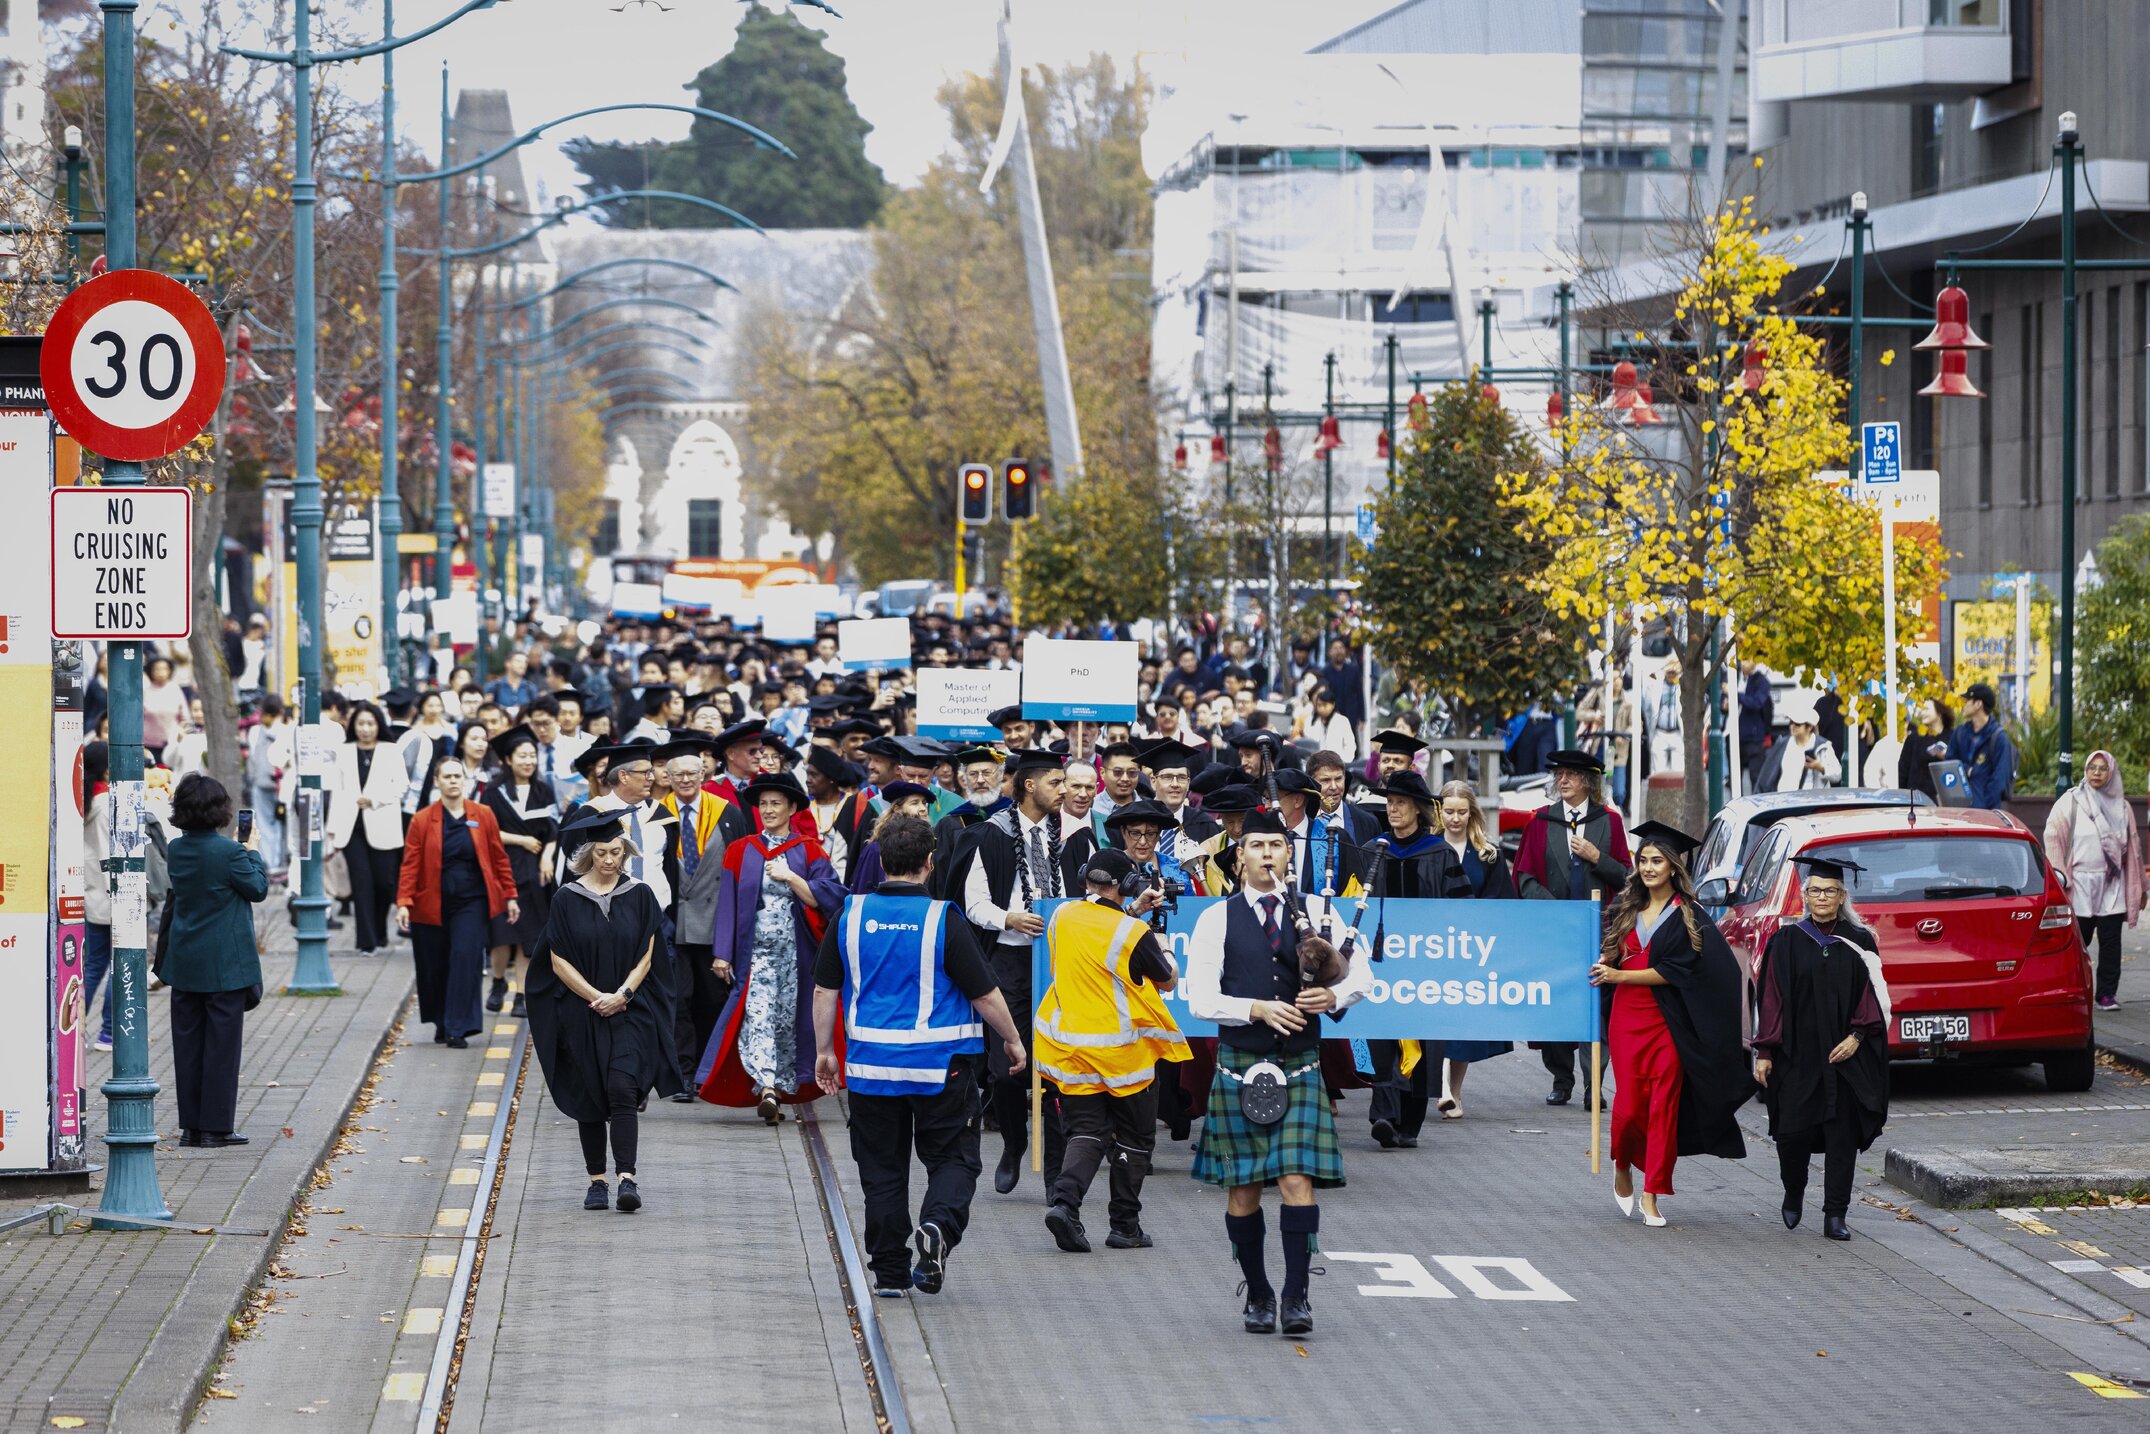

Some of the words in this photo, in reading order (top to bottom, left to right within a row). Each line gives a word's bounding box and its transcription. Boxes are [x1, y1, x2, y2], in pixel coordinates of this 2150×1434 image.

[85, 331, 182, 400] 30
[5, 387, 46, 399] PHANT
[0, 441, 17, 451] ur
[1873, 445, 1891, 460] 120
[107, 499, 133, 524] NO
[74, 533, 168, 560] CRUISING
[95, 567, 146, 594] ZONE
[95, 602, 146, 629] ENDS
[1071, 668, 1089, 676] PhD
[944, 683, 978, 691] Master
[982, 683, 991, 691] of
[948, 694, 988, 703] Applied
[939, 707, 995, 715] Computing
[2011, 911, 2033, 920] i30
[1, 935, 16, 947] of
[1360, 926, 1496, 967] versity
[1368, 971, 1550, 1005] ocession
[1903, 1019, 1967, 1037] GRP50
[1323, 1251, 1577, 1301] 30
